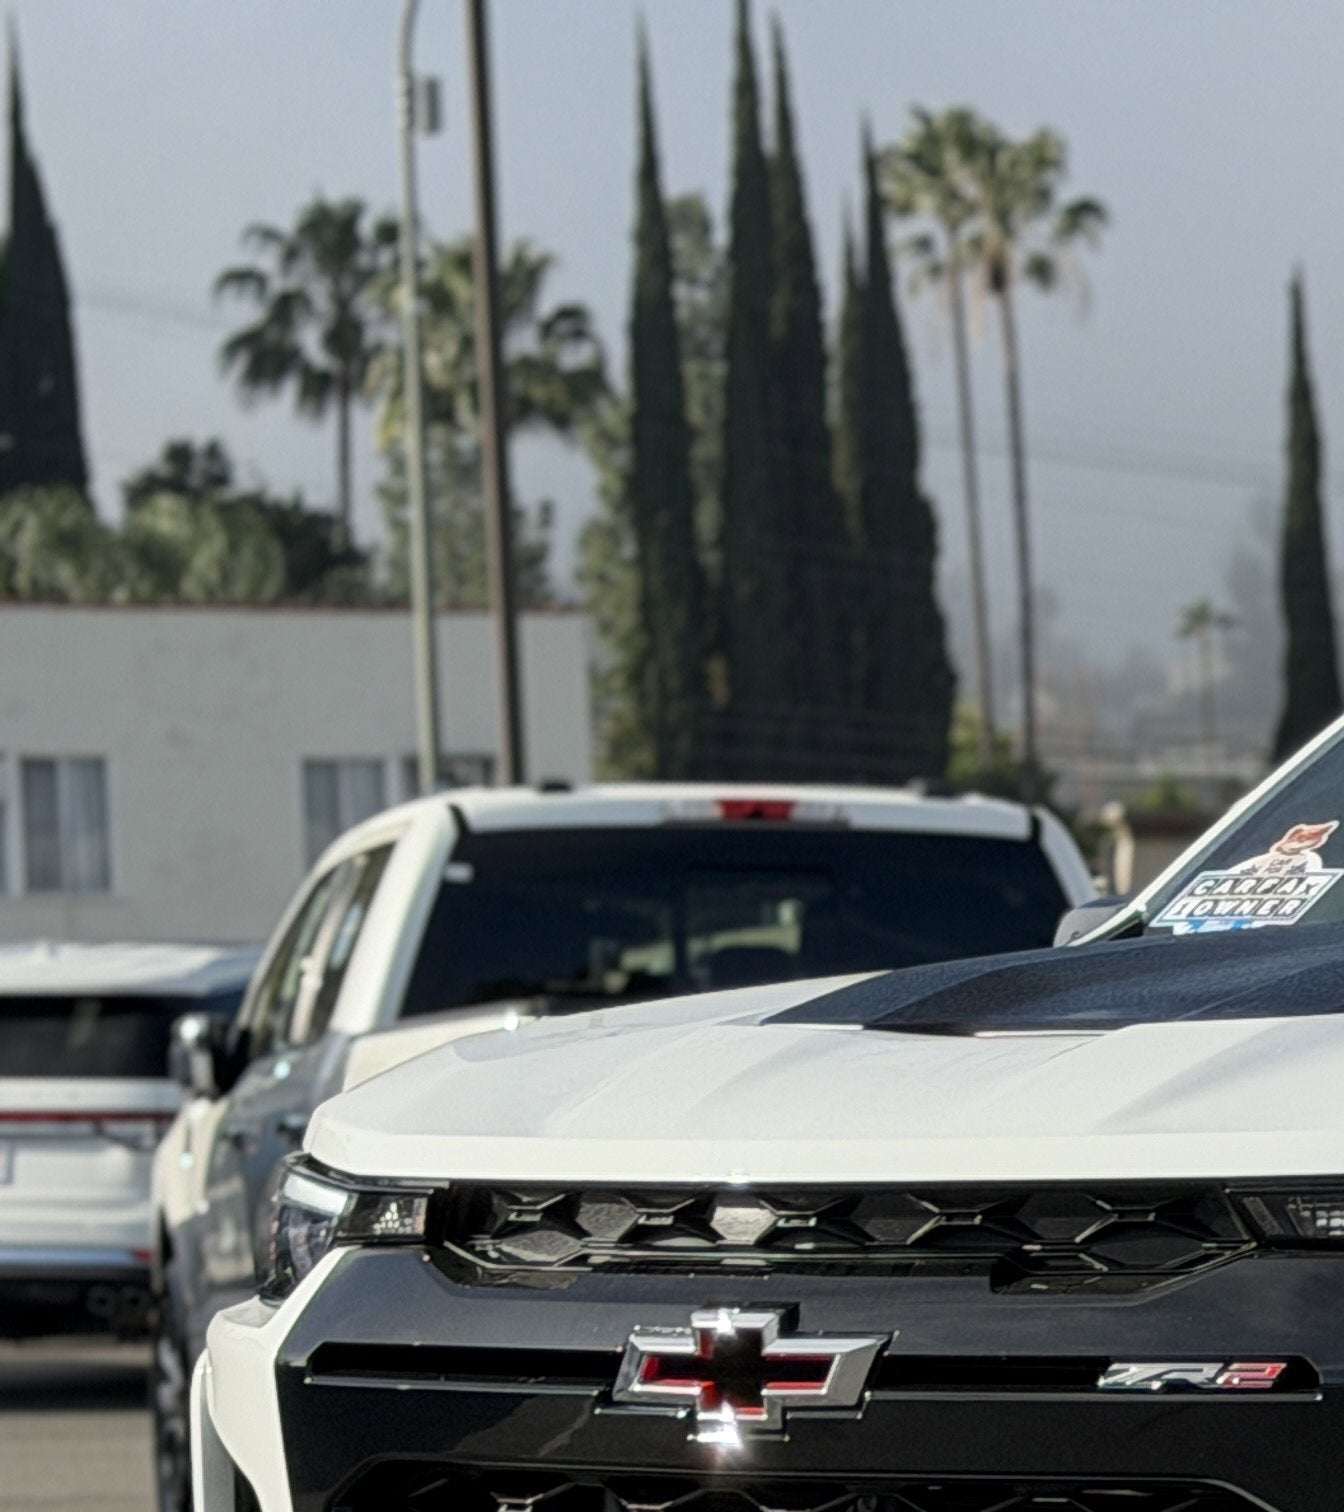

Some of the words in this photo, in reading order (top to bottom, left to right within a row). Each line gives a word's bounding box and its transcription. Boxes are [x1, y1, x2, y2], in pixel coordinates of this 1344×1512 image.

[1193, 877, 1322, 896] CARFAX
[1193, 899, 1302, 917] OWNER
[1099, 1362, 1288, 1390] ZR2
